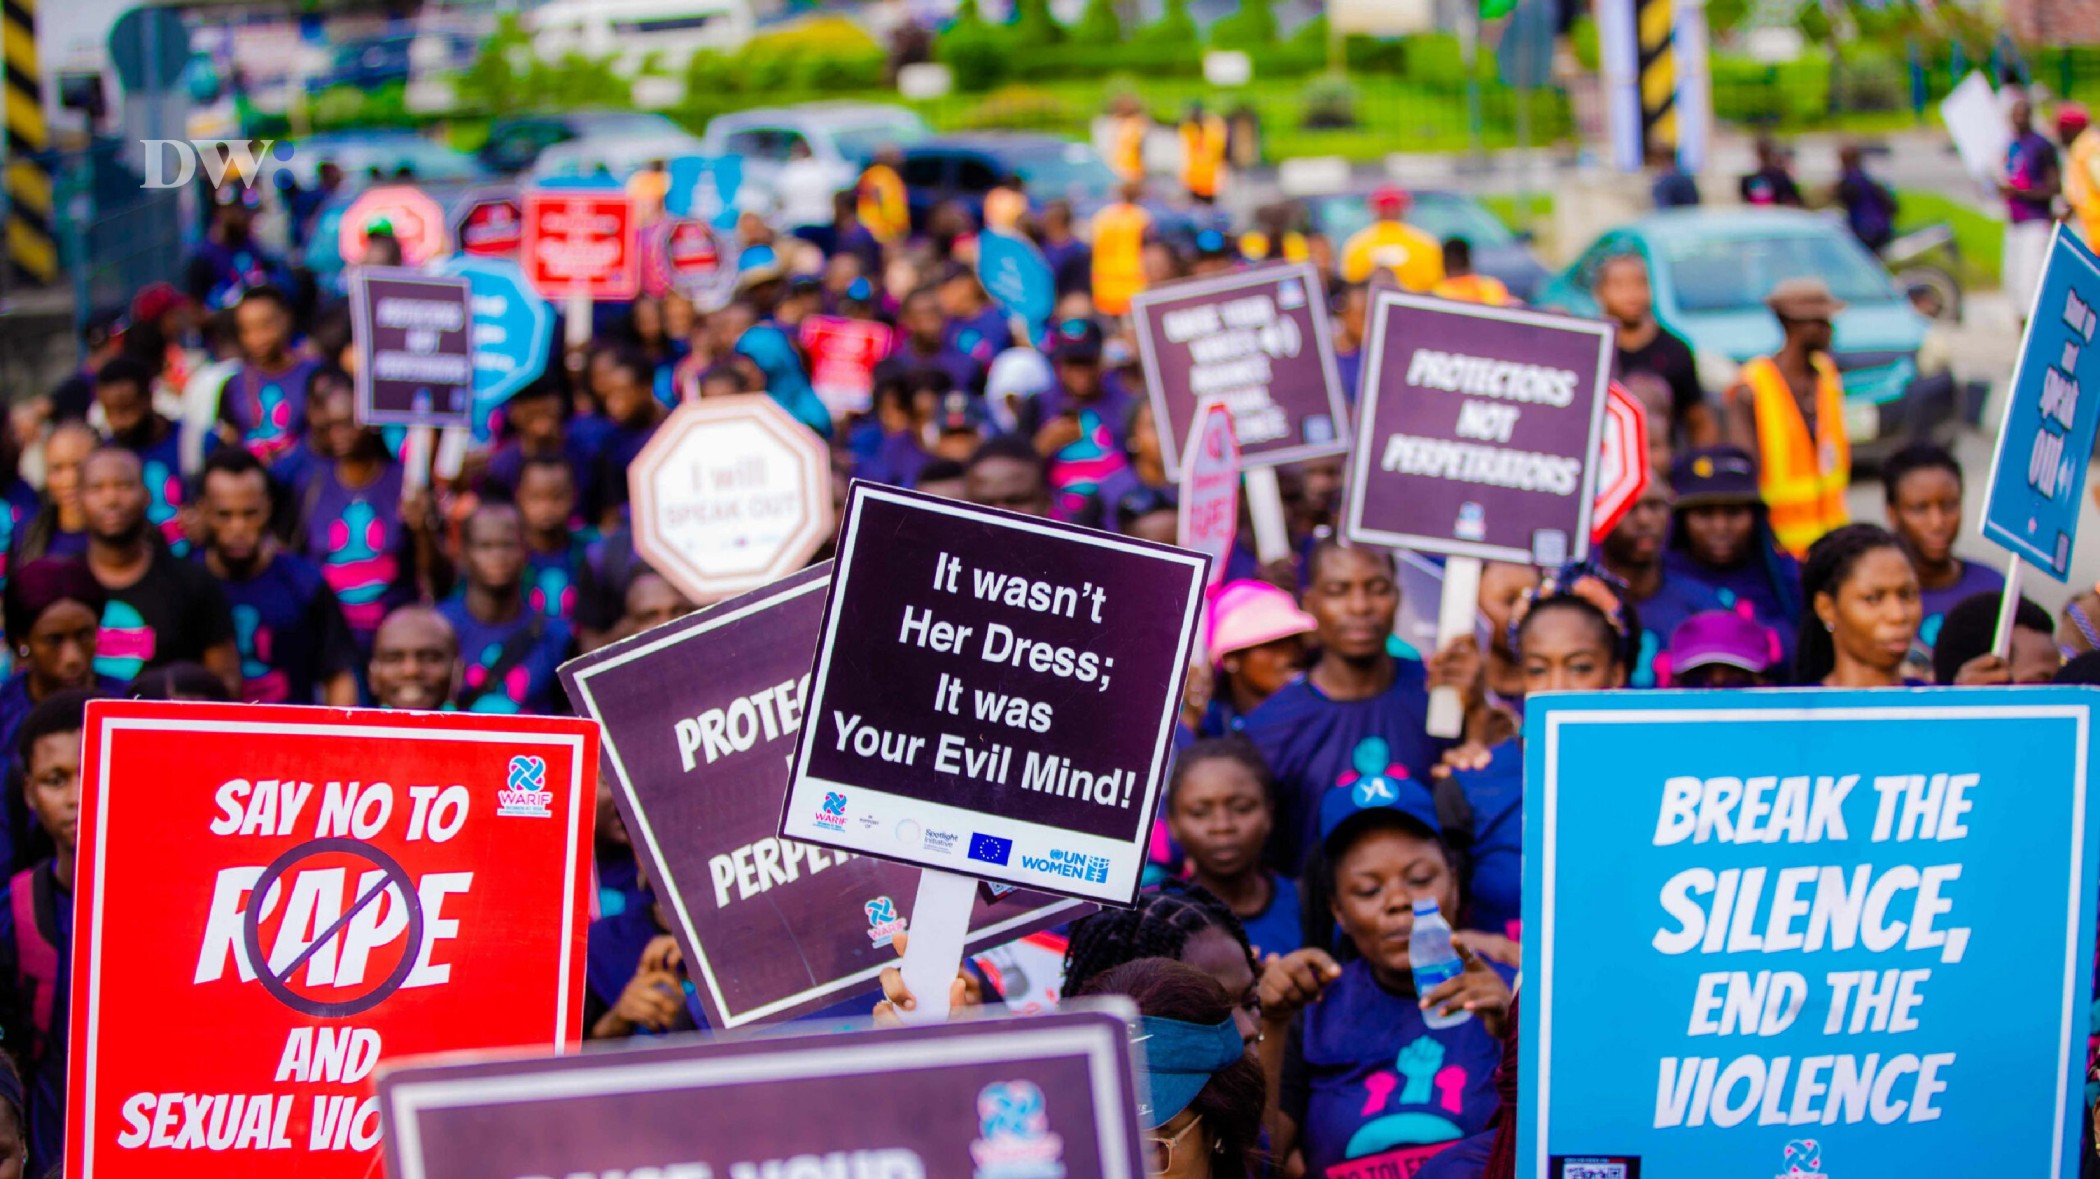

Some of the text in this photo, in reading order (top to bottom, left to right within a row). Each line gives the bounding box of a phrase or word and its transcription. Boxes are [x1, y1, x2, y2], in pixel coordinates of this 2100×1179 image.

[1406, 348, 1578, 407] PROTECTORS
[1456, 399, 1521, 443] NOT
[1381, 433, 1581, 496] PERPETRATORS
[933, 552, 1106, 624] It wasn’t
[899, 605, 1114, 692] Her Dress;
[934, 673, 1053, 733] It was
[833, 710, 1136, 809] Your Evil Mind!
[209, 778, 470, 843] SAY NO TO
[500, 792, 550, 806] WARIF
[815, 812, 848, 826] WARIF
[1652, 773, 1981, 846] BREAK THE
[925, 829, 958, 842] Spotlight
[1064, 851, 1087, 867] UN
[1022, 855, 1084, 879] WOMEN
[193, 866, 474, 990] RAPE
[1651, 863, 1971, 963] SILENCE,
[1687, 968, 1932, 1037] END THE
[274, 1026, 382, 1084] AND
[117, 1091, 295, 1150] SEXUAL
[1653, 1052, 1956, 1129] VIOLENCE
